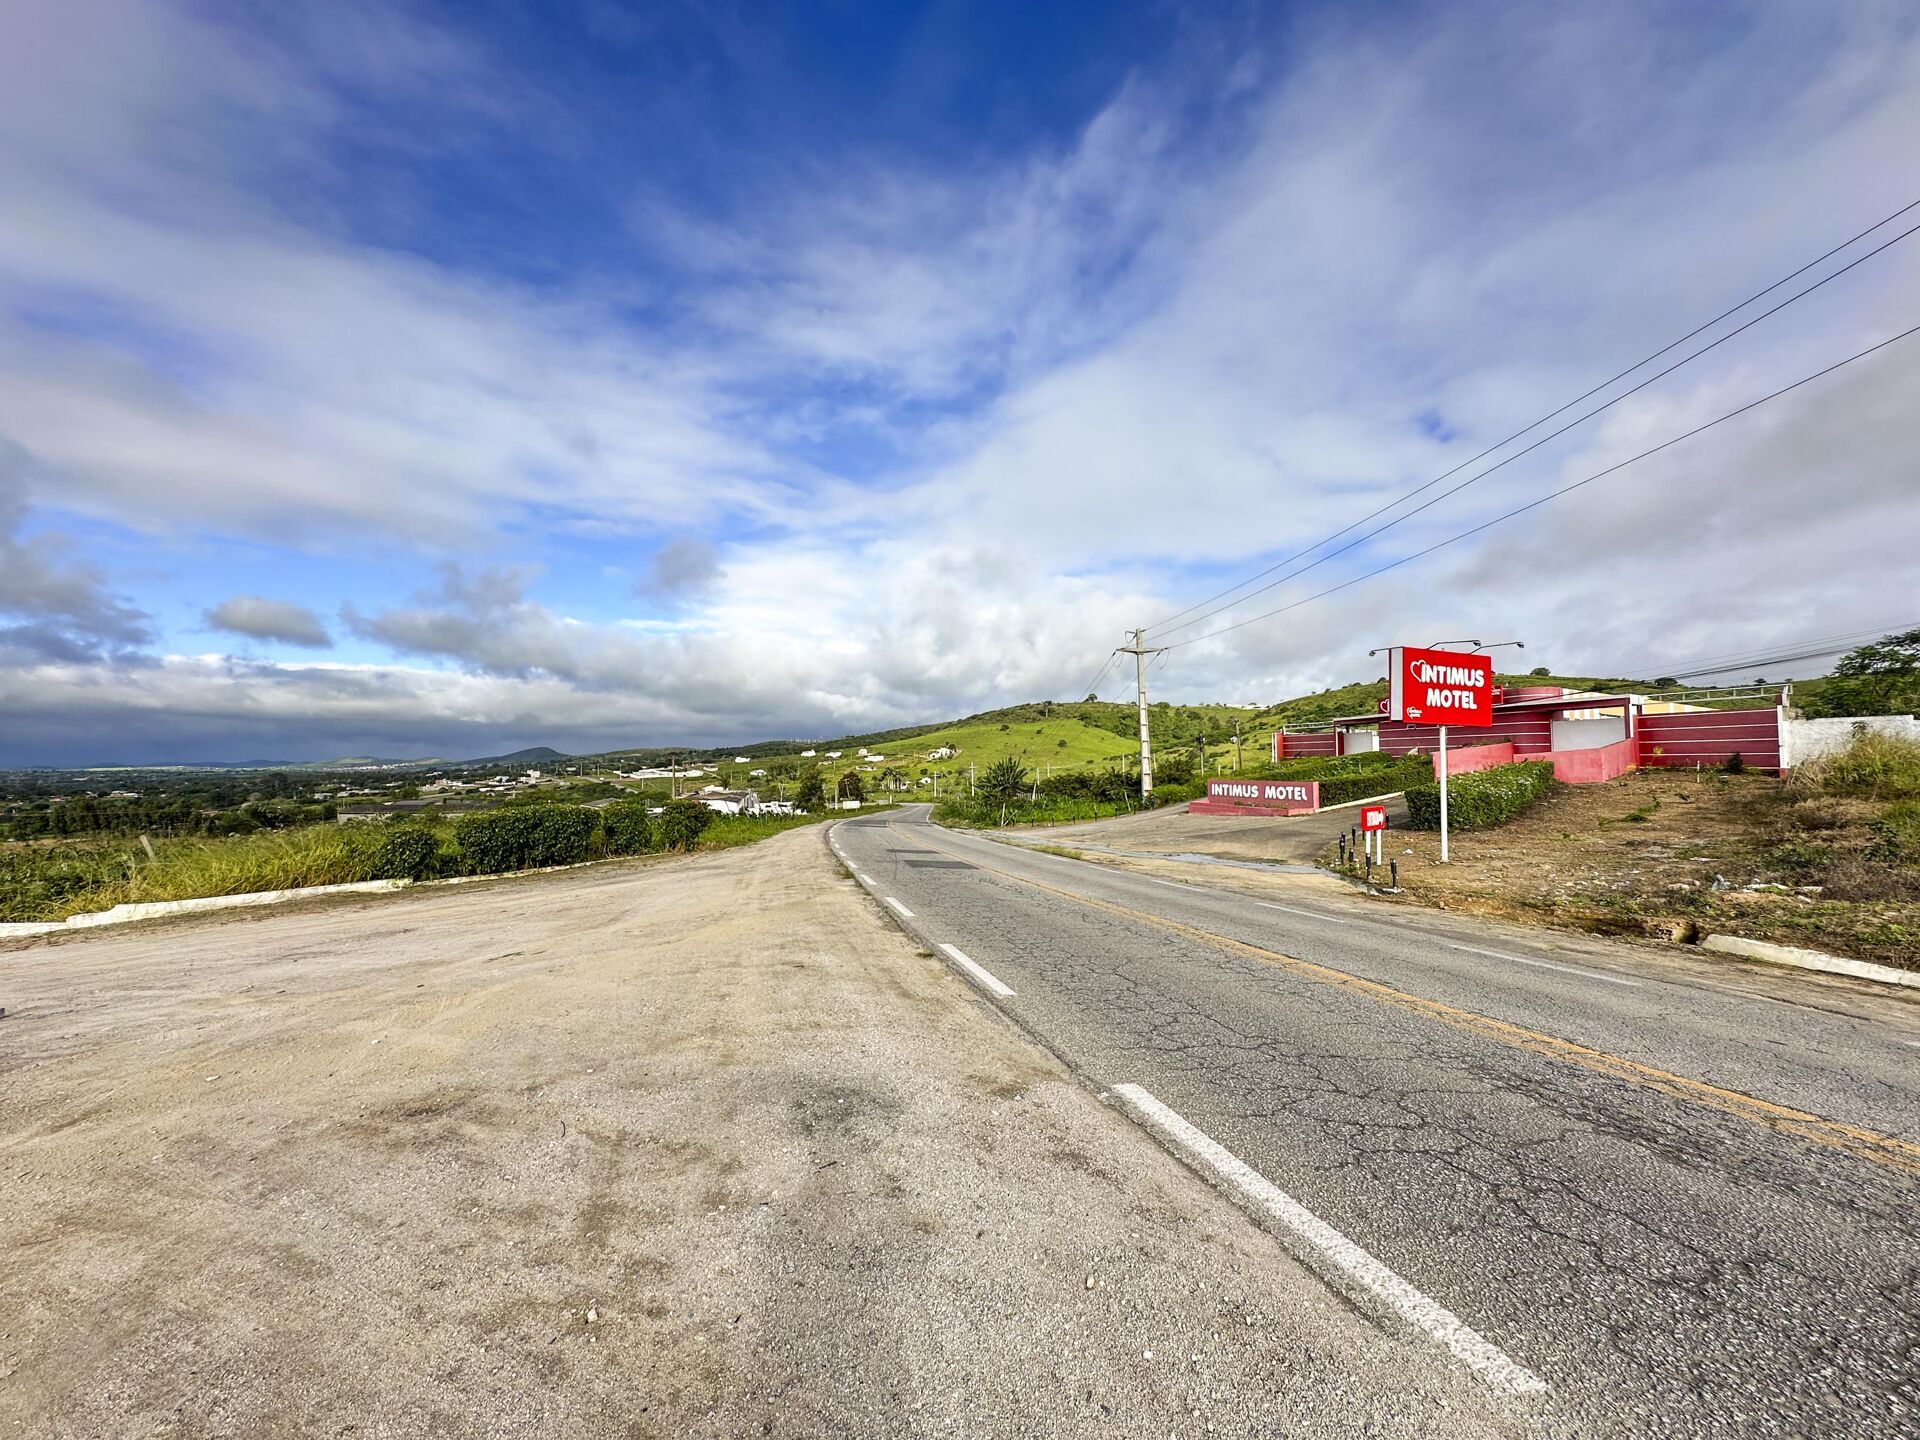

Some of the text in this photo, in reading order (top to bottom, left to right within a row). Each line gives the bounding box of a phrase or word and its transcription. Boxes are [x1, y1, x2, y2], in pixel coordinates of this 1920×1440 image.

[1421, 664, 1484, 687] INTIMUS
[1426, 688, 1478, 710] MOTEL
[1211, 783, 1308, 801] INTIMUS MOTEL
